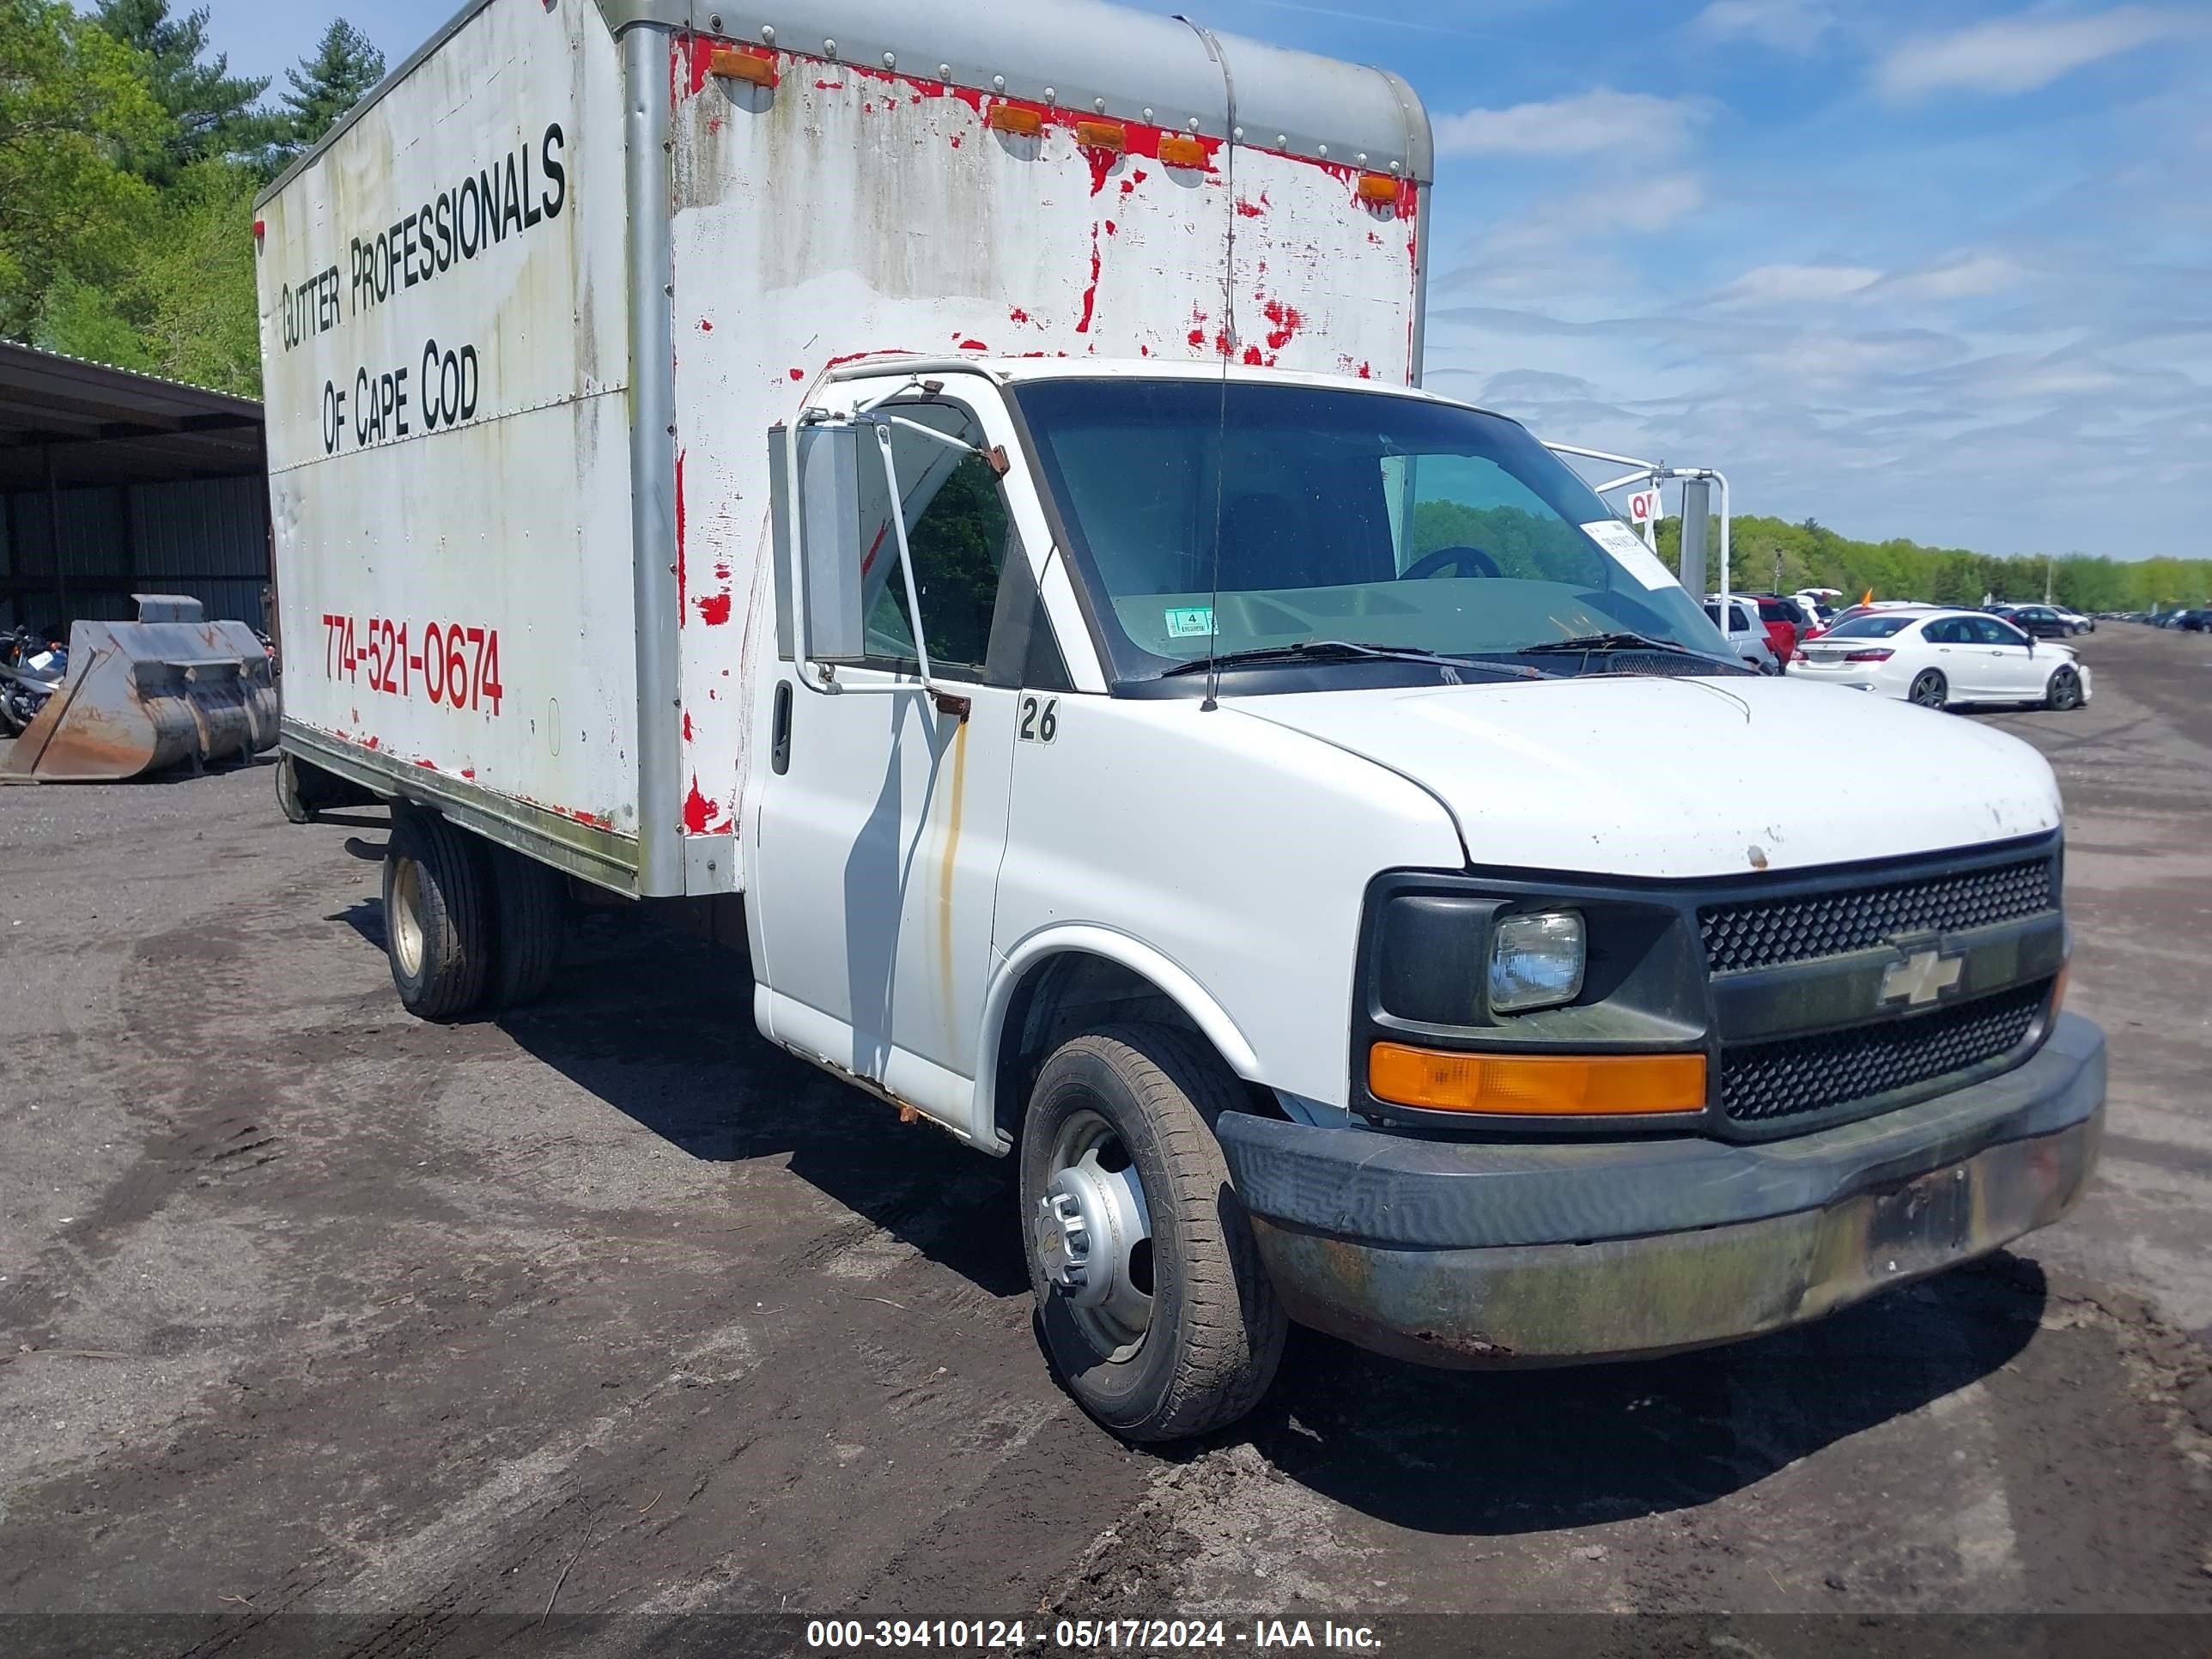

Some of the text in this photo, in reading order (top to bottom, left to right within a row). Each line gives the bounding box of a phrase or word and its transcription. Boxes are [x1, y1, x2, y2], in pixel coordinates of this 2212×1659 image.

[282, 122, 565, 353] GUTTER PROFESSIONALS
[355, 366, 409, 447] CAPE
[421, 338, 479, 430] COD
[323, 614, 502, 716] 774-521-0674
[1188, 614, 1197, 623] 4
[1020, 696, 1058, 742] 26
